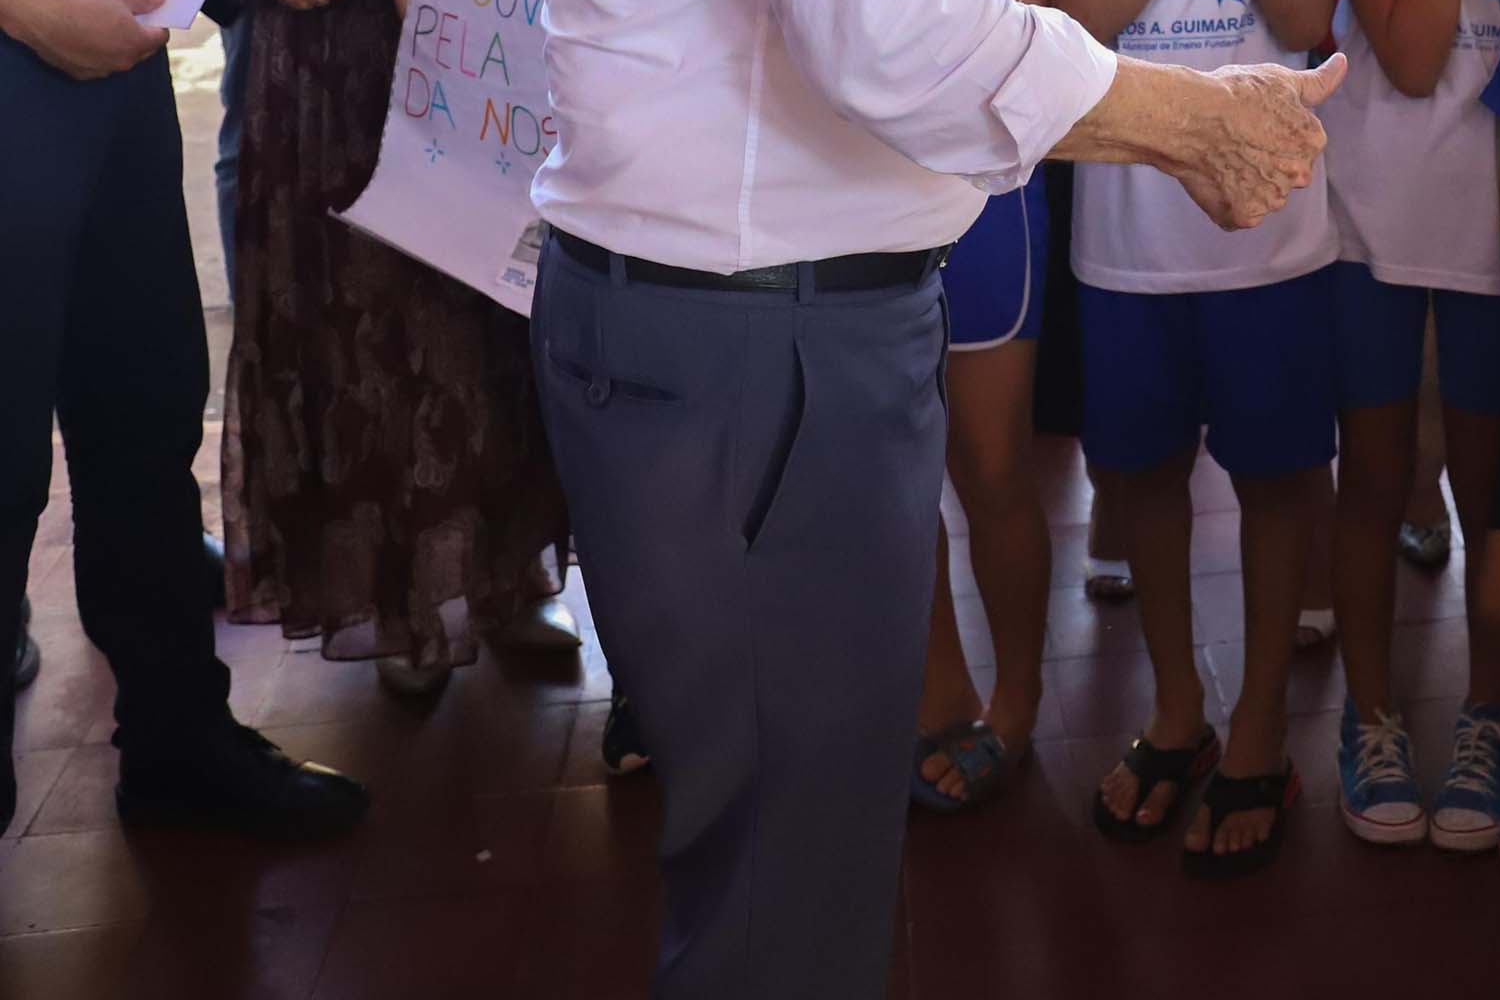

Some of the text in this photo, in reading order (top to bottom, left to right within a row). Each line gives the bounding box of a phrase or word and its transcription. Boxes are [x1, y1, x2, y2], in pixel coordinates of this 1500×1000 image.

[412, 4, 511, 86] PELA
[1150, 21, 1166, 35] A.
[404, 67, 457, 131] DA
